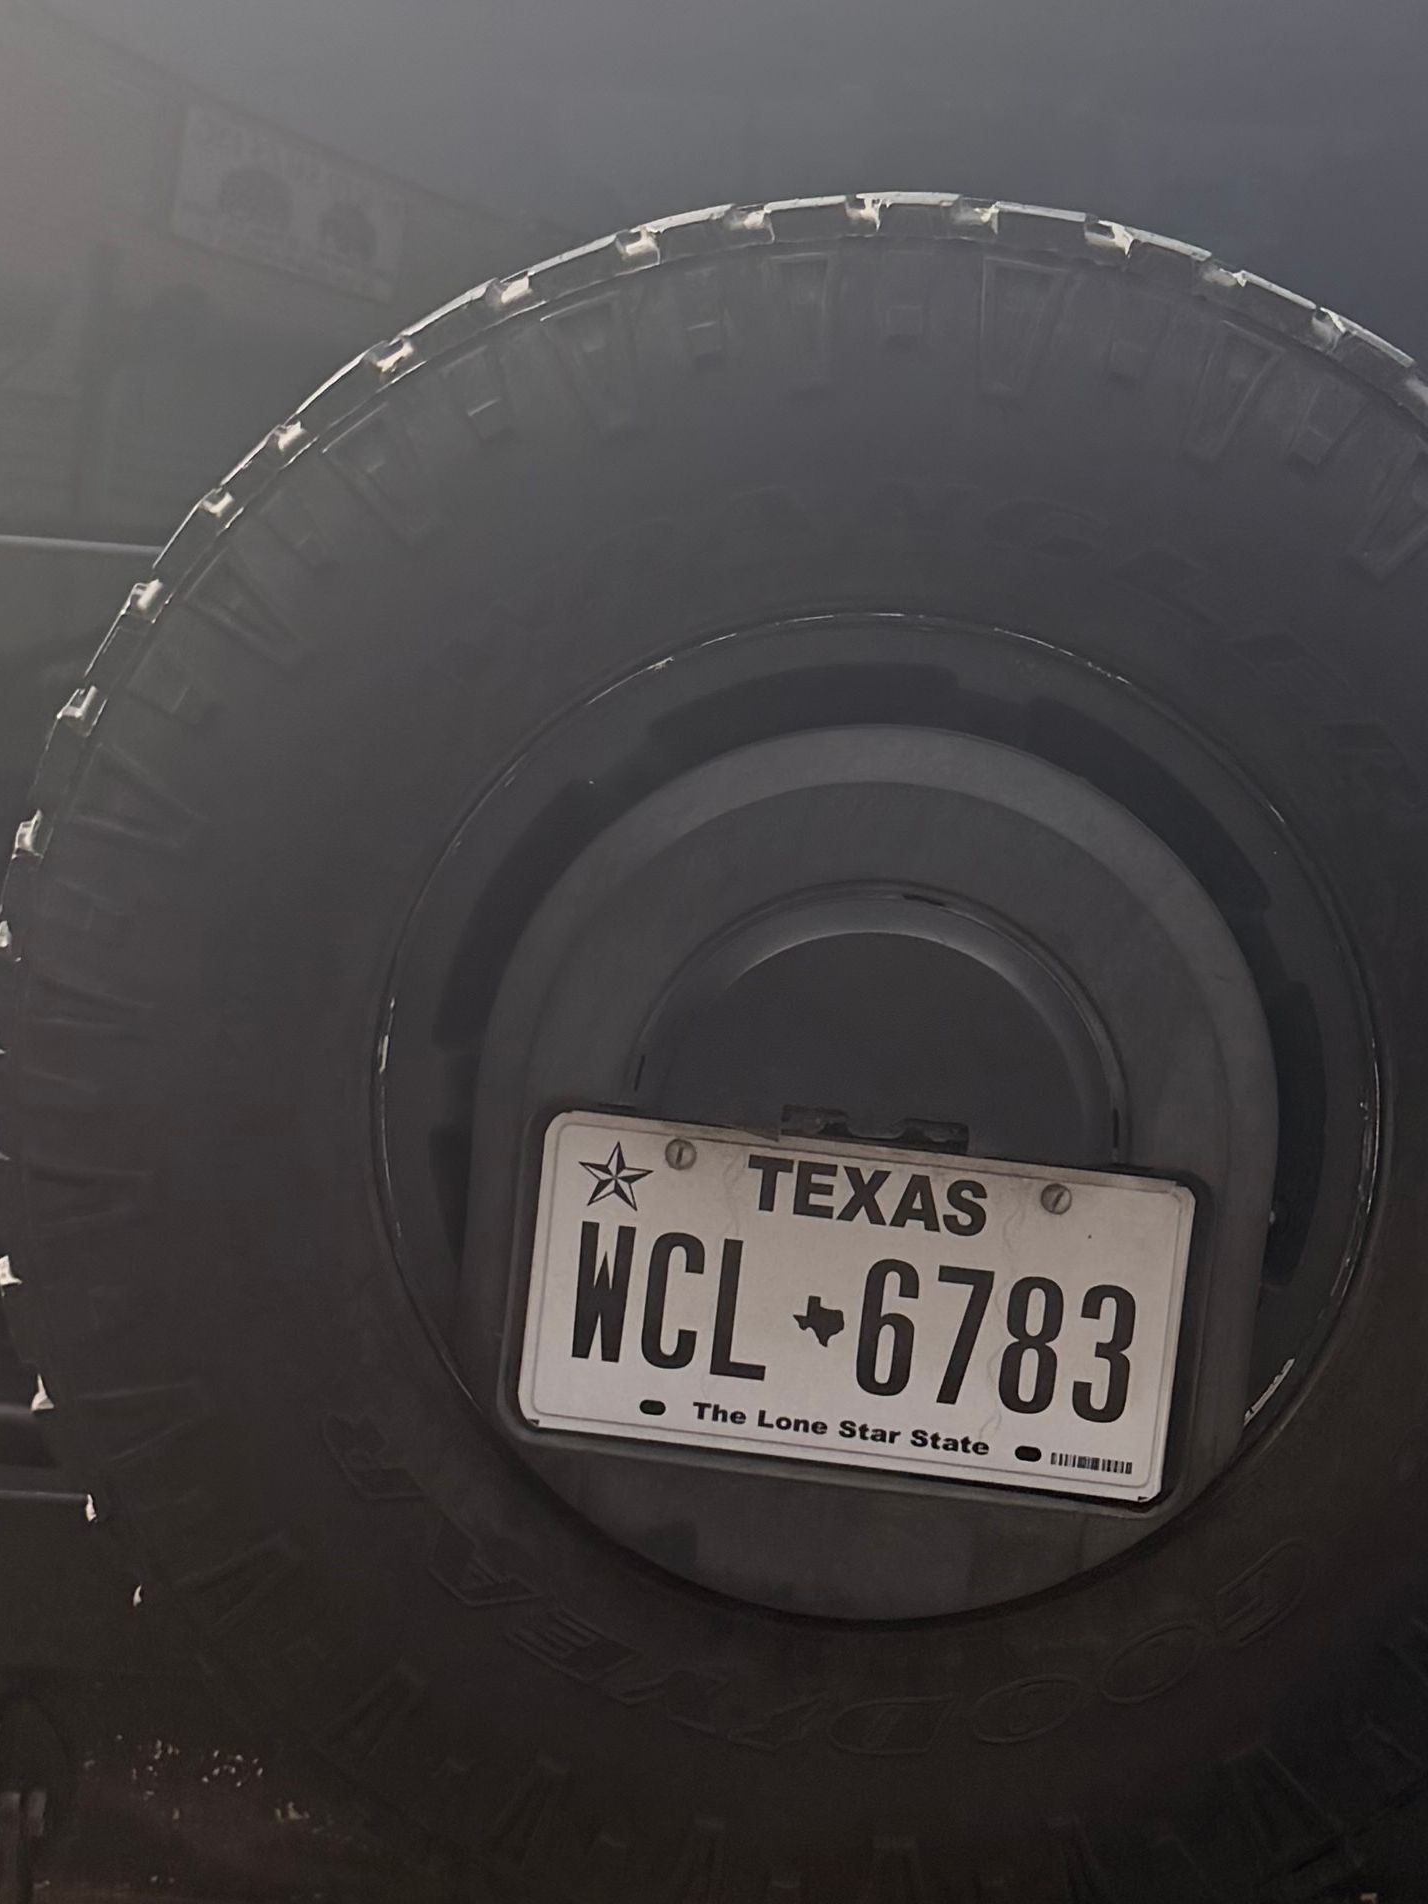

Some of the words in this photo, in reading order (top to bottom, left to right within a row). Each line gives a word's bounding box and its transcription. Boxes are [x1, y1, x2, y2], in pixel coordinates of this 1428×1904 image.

[748, 1153, 988, 1237] TEXAS
[571, 1221, 766, 1382] WCL
[855, 1258, 1137, 1424] 6783
[693, 1401, 747, 1428] The
[757, 1409, 828, 1438] Lone
[838, 1418, 901, 1447] Star
[910, 1428, 991, 1457] State
